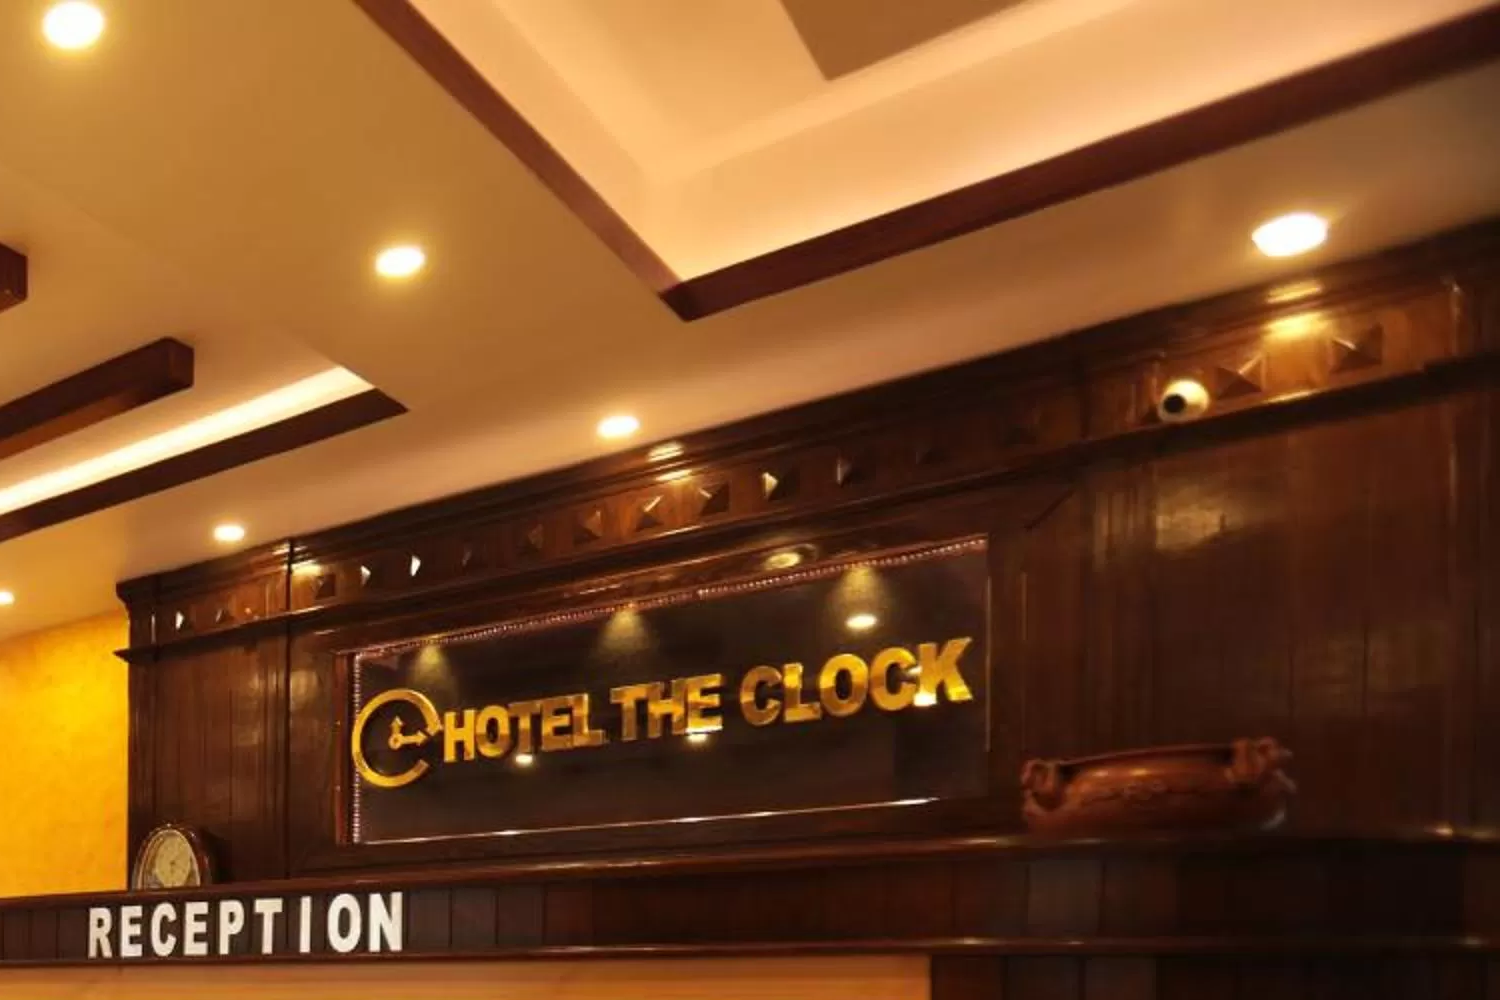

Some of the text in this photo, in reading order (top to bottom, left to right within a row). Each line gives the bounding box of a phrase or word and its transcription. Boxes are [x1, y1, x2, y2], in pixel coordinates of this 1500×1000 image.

[443, 637, 974, 763] HOTEL THE CLOCK
[88, 891, 403, 959] RECEPTION
